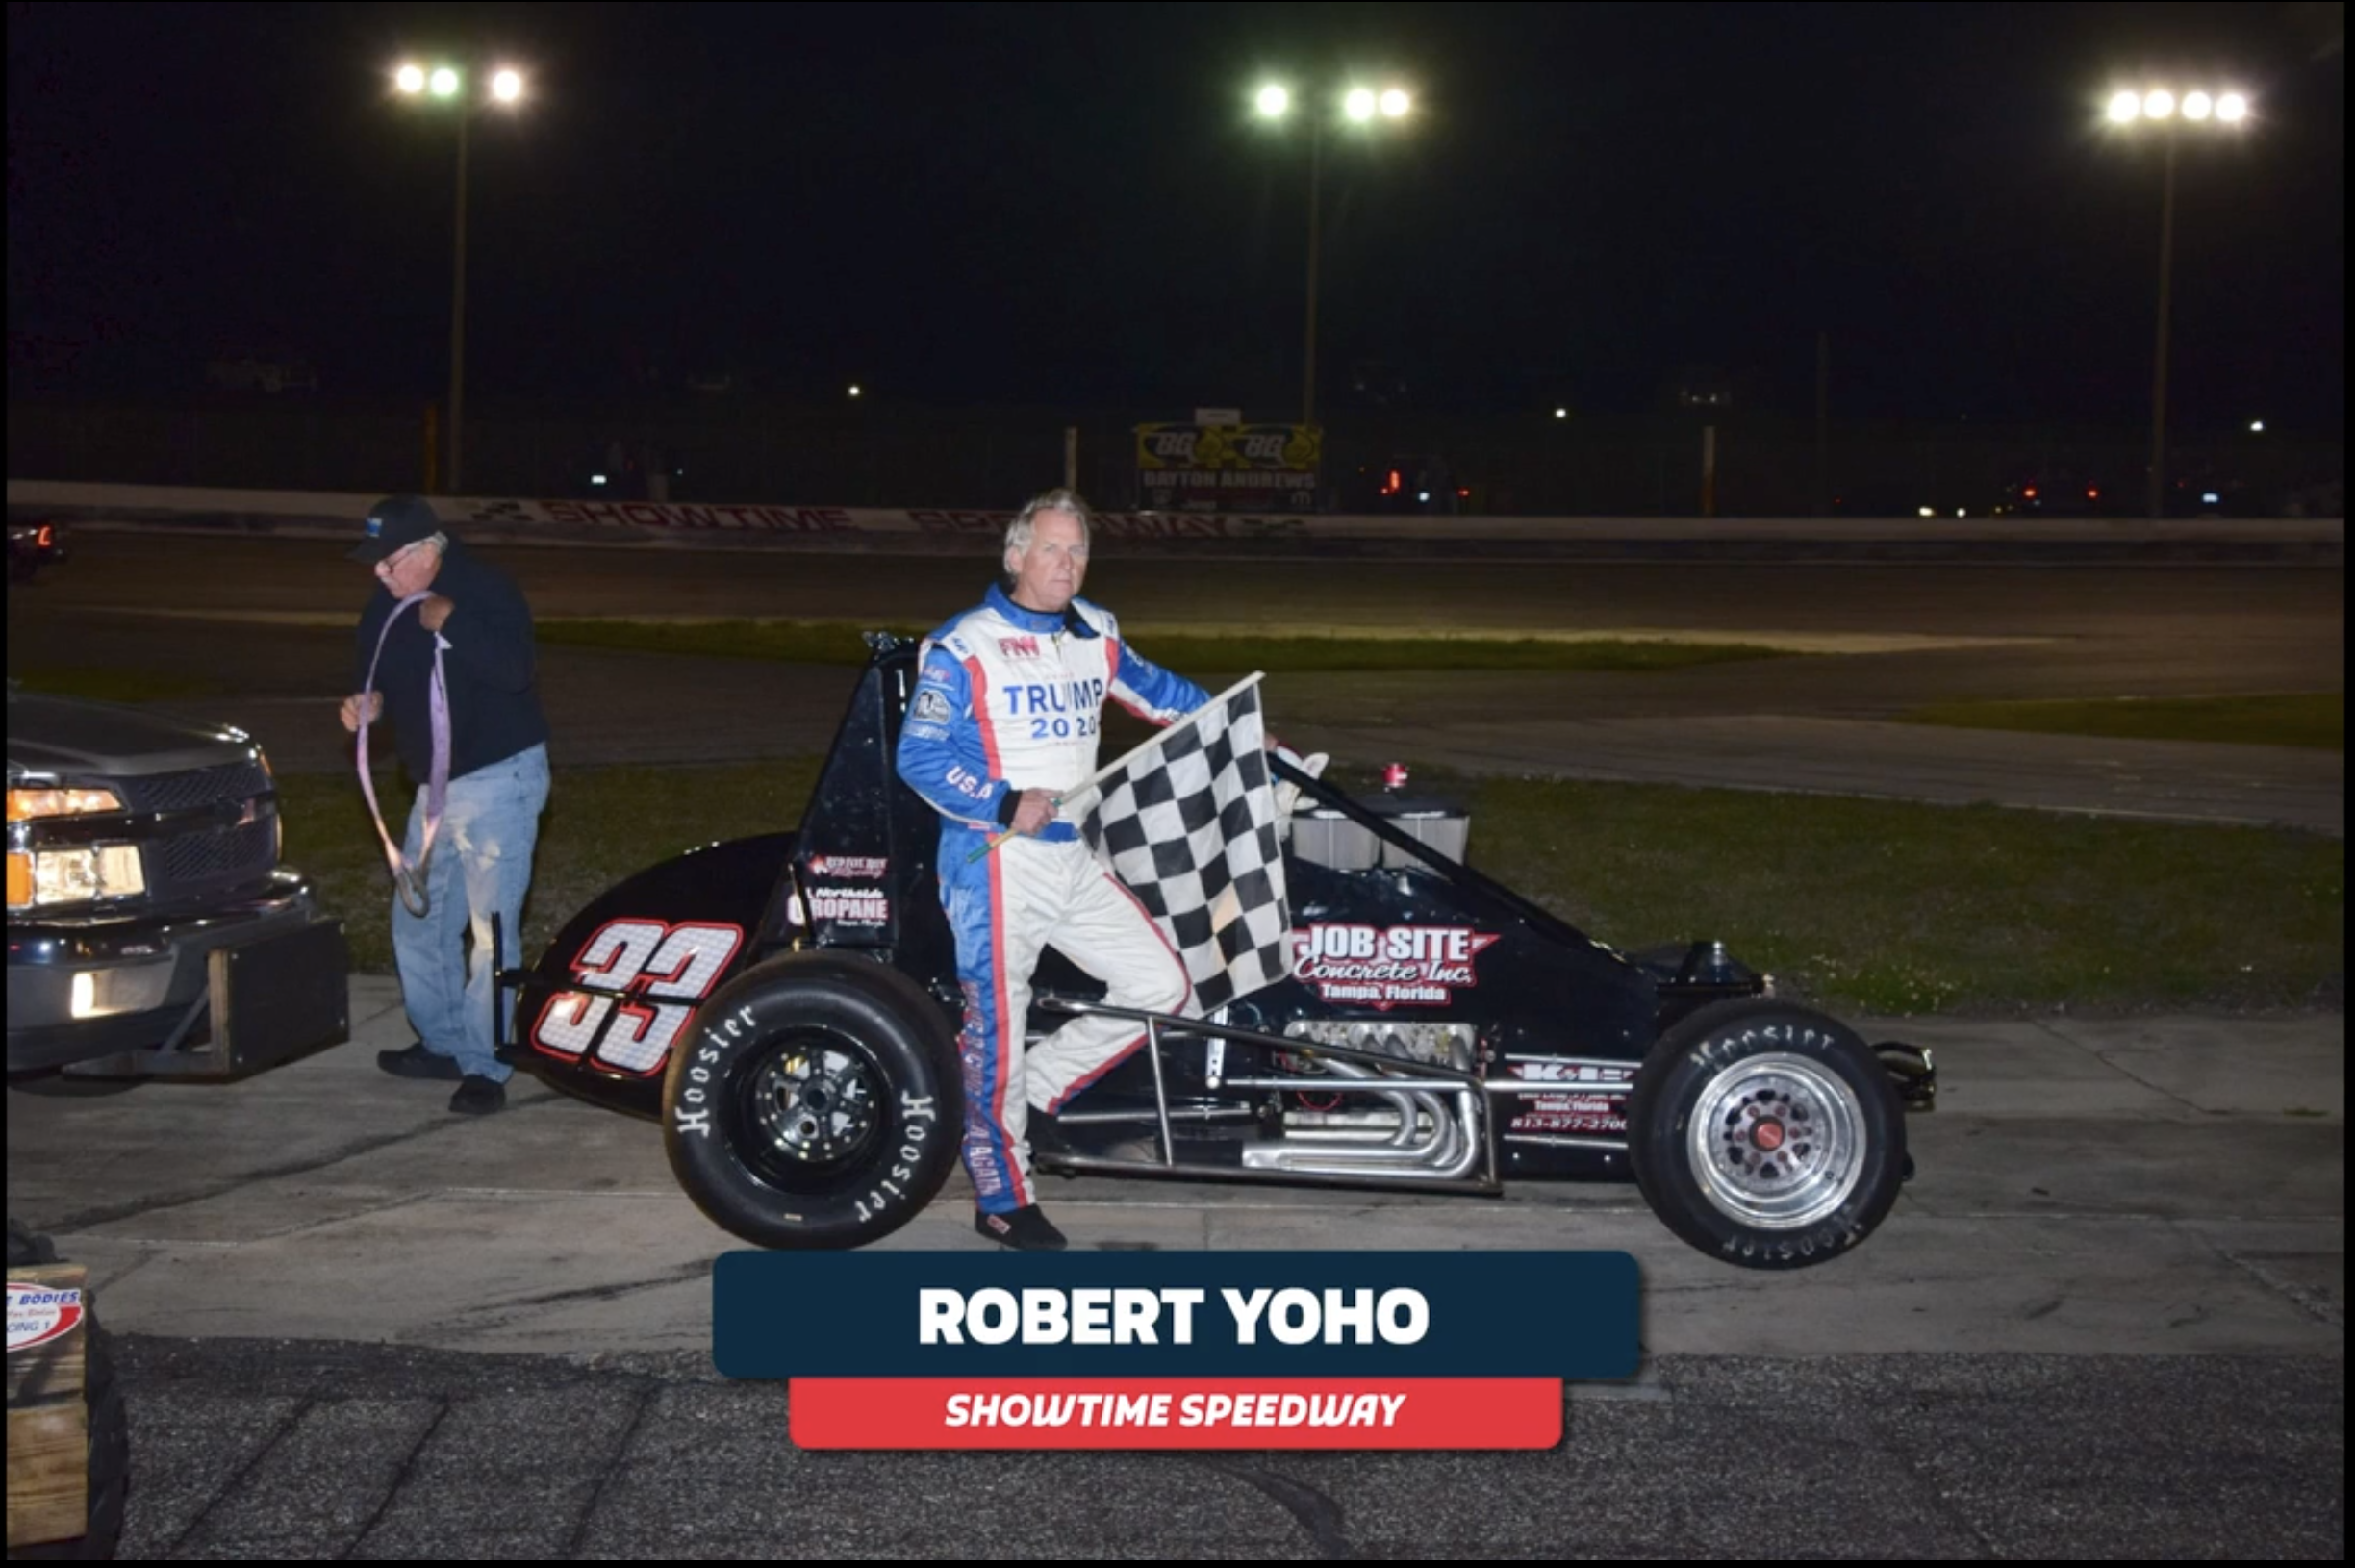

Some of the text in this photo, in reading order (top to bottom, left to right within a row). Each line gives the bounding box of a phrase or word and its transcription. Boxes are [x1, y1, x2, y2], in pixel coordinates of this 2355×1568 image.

[539, 501, 861, 533] SHOWTIME
[1002, 678, 1102, 715] TRUMP
[1030, 715, 1097, 739] 2020
[1299, 925, 1470, 961] JOB SITE
[1293, 957, 1417, 980] Concrete
[1385, 985, 1446, 1001] Florida
[675, 1005, 757, 1138] Hoosier
[854, 1090, 937, 1223] Hoosier
[19, 1292, 79, 1305] BODIES
